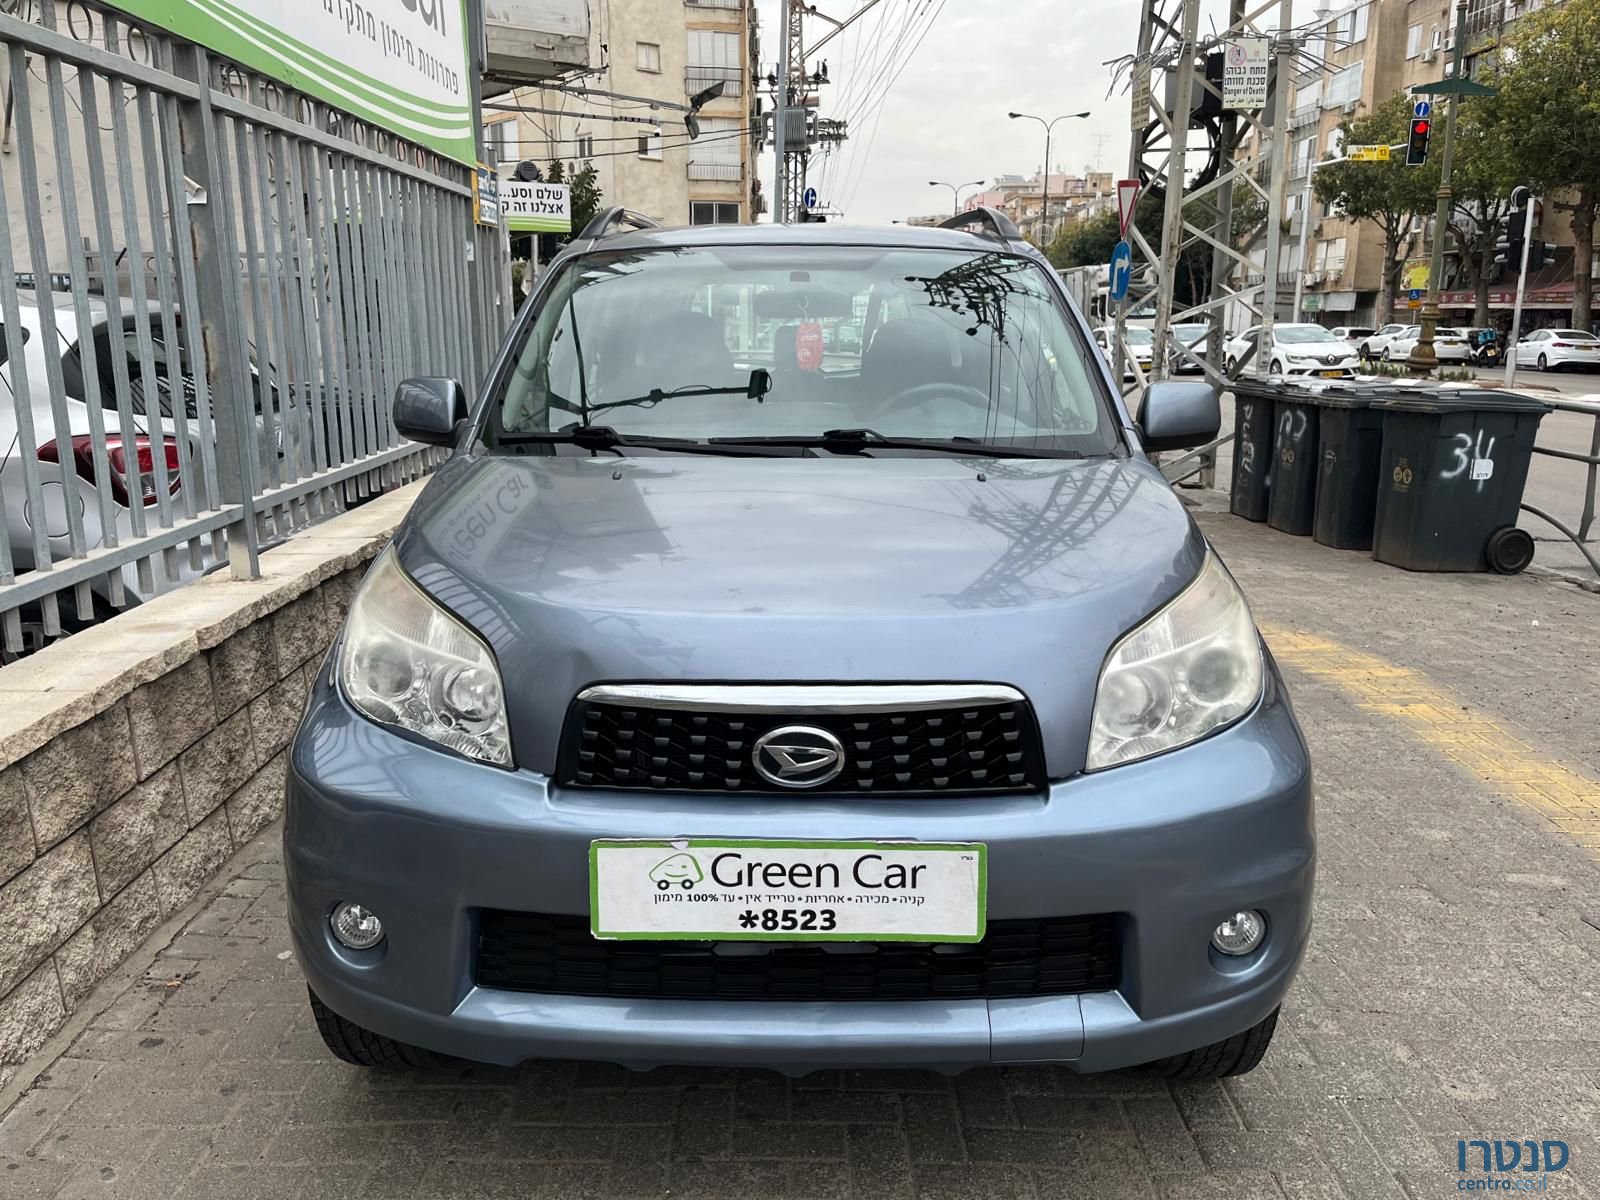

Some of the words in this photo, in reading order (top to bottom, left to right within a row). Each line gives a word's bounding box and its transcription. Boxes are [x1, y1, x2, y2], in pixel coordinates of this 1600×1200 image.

[380, 21, 415, 67] מימון
[418, 48, 459, 95] פתרונות
[1249, 66, 1267, 75] מתח
[1246, 77, 1266, 86] סכנת
[1224, 87, 1241, 97] Danger
[1242, 87, 1249, 95] of
[536, 187, 563, 201] שלם
[513, 202, 528, 213] זה
[530, 201, 564, 214] אצלנו
[710, 852, 840, 888] Green
[852, 853, 927, 889] Car
[653, 893, 683, 905] מימון
[686, 893, 719, 903] 100%
[720, 893, 736, 903] עד
[745, 893, 762, 905] אין
[765, 893, 796, 903] טרייד
[805, 893, 845, 904] אחריות
[855, 894, 890, 904] מכירה
[899, 895, 925, 906] קניה
